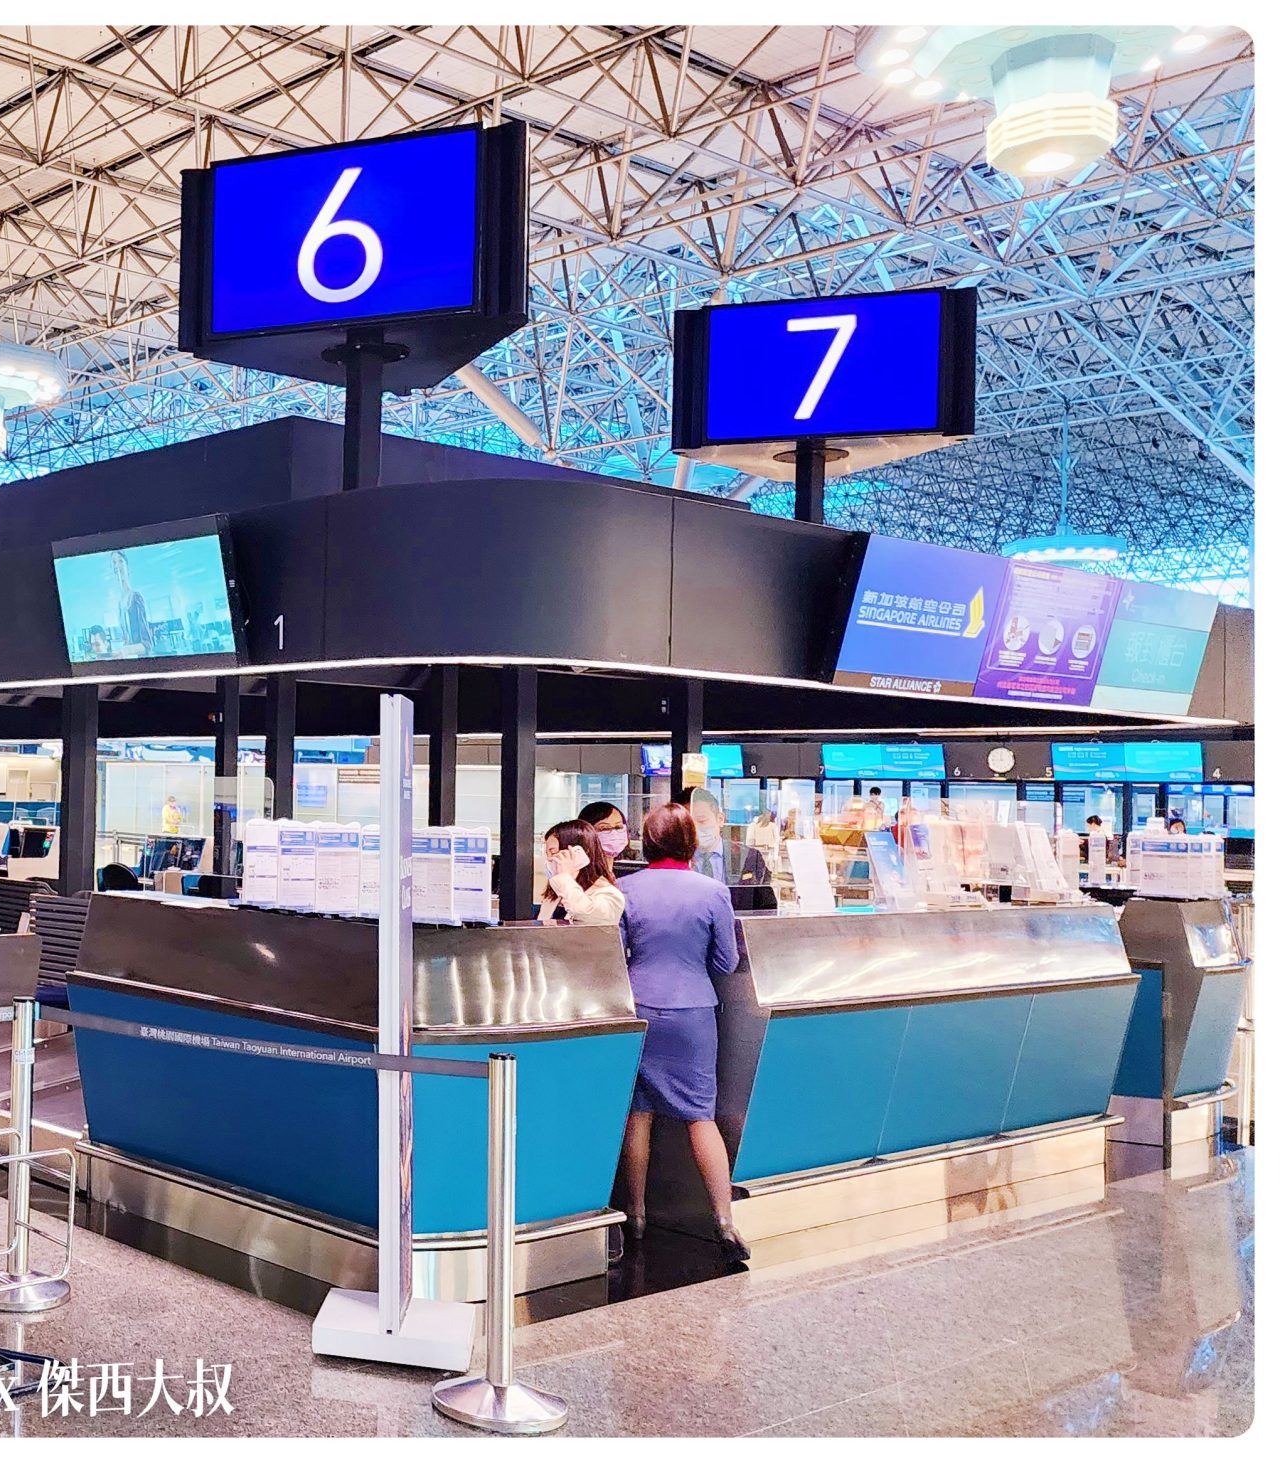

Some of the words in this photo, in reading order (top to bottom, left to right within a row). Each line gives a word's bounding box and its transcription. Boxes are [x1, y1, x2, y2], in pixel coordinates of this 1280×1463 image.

[297, 167, 383, 303] 6
[787, 314, 857, 420] 7
[862, 589, 967, 617] 新加坡航空公司
[858, 605, 917, 624] SINGAPORE
[918, 613, 962, 631] AIRLINES
[273, 614, 284, 650] 1
[870, 676, 892, 689] STAR
[894, 678, 933, 693] ALLIANCE
[750, 764, 757, 775] 8
[953, 766, 962, 777] 6
[1045, 767, 1053, 777] 5
[1213, 768, 1222, 779] 4
[211, 1037, 240, 1050] Taiwan
[242, 1041, 278, 1055] Taoyuan
[280, 1045, 336, 1061] International
[337, 1052, 371, 1066] Airport
